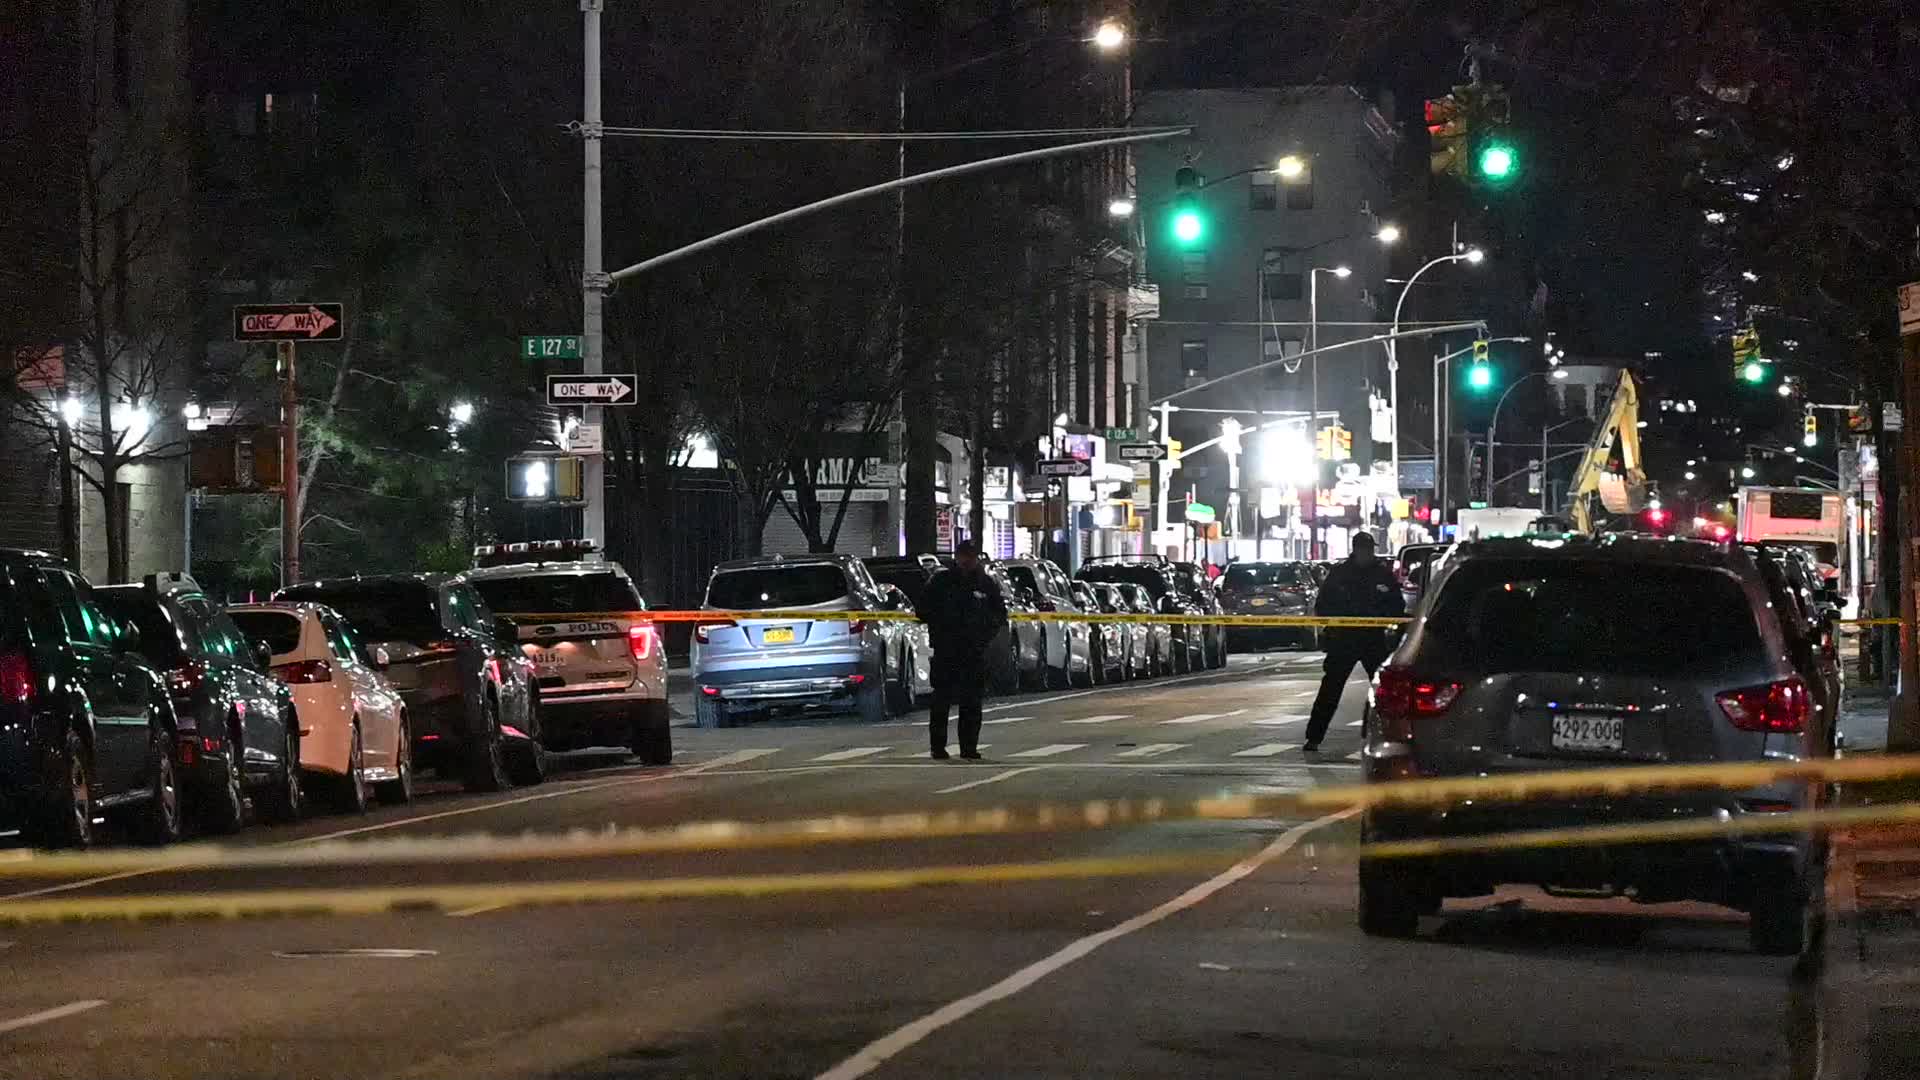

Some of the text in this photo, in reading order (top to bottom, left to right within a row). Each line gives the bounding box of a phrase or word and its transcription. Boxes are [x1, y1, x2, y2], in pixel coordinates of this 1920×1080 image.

[246, 315, 322, 330] ONE WAY
[528, 339, 536, 355] E
[543, 339, 561, 355] 127
[561, 385, 622, 396] ONE WAY
